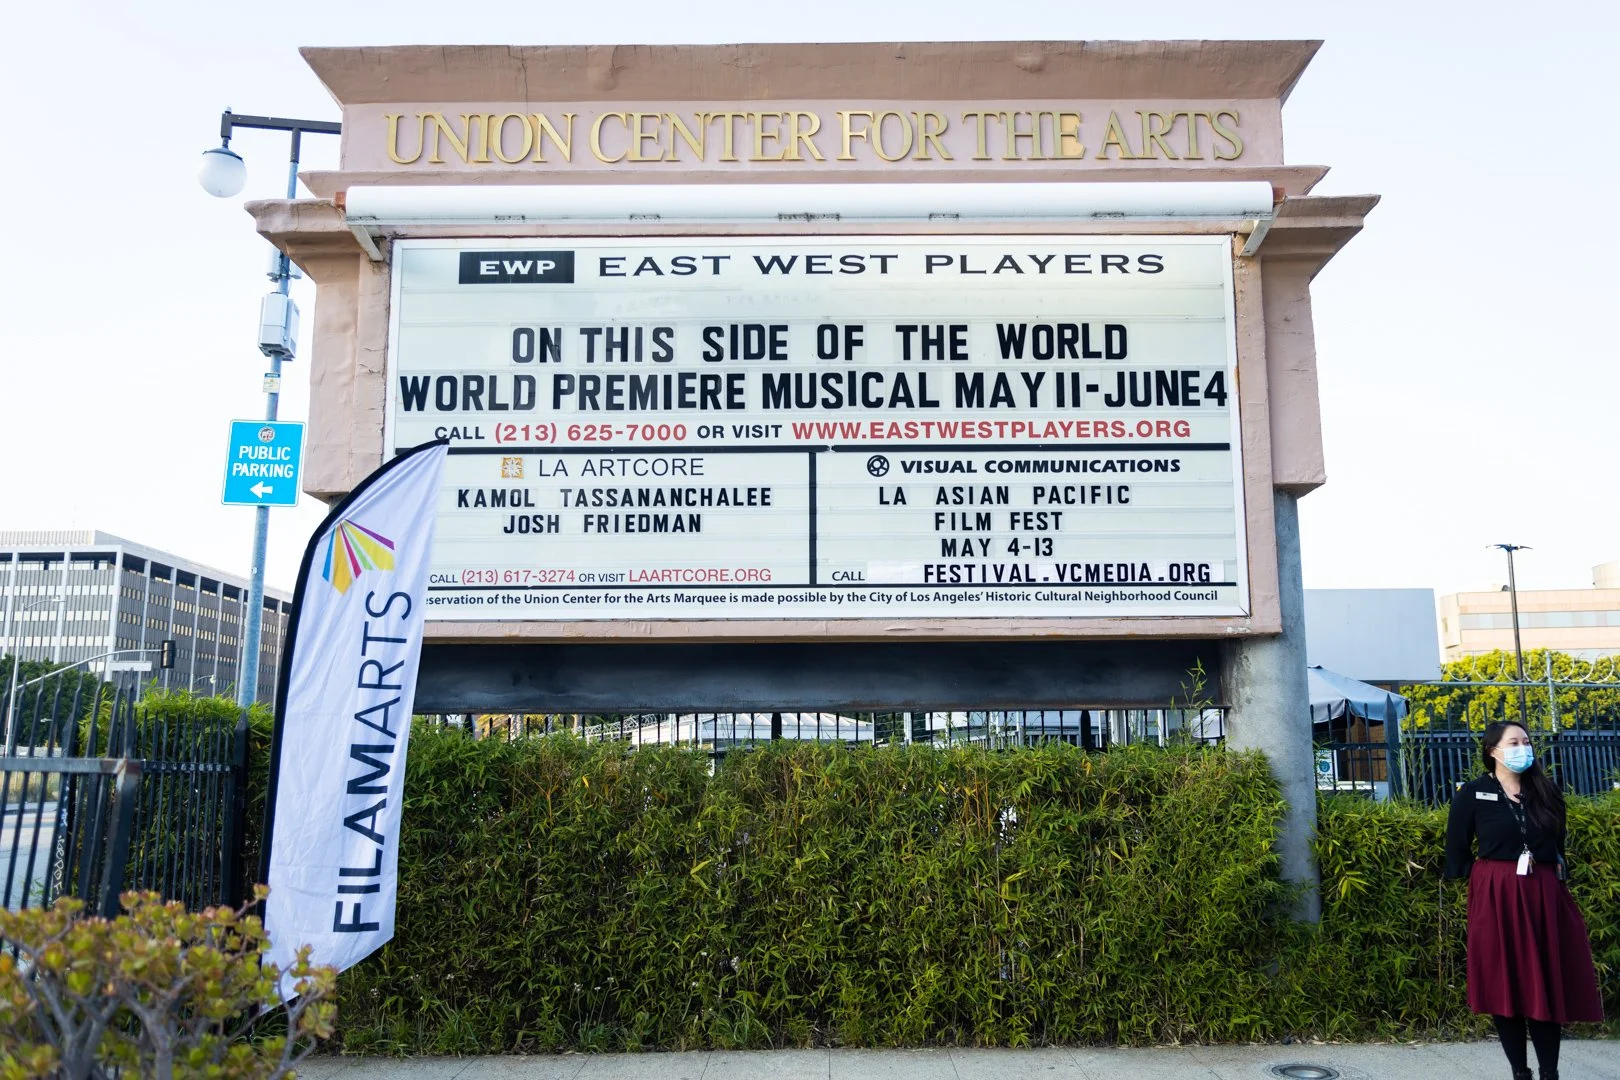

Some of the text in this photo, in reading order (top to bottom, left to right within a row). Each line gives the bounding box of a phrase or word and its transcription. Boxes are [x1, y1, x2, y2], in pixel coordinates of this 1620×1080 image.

[384, 109, 1245, 165] UNION CENTER FOR THE ARTS
[479, 260, 557, 276] EWP
[599, 253, 1166, 277] EAST WEST PLAYERS
[512, 322, 1128, 364] ON THIS SIDE OF THE WORLD
[400, 373, 536, 412] WORLD
[552, 372, 746, 411] PREMIERE
[762, 370, 940, 410] MUSICAL
[434, 420, 1191, 444] CALL (213) 625-7000 OR VISIT WWW.EASTWESTPLAYERS.ORG
[238, 445, 291, 461] PUBLIC
[231, 462, 294, 478] PARKING
[538, 457, 705, 477] LA ARTCORE
[900, 458, 1181, 474] VISUAL COMMUNICATIONS
[457, 487, 772, 508] KAMOL TASSANANCHALEE
[879, 485, 1130, 506] LA ASIAN PACIFIC
[503, 513, 701, 534] JOSH FRIEDMAN
[934, 511, 1063, 531] FILM FEST
[941, 537, 1054, 557] MAY 4-13
[429, 568, 772, 585] CALL (213) 617-3274 OR VISIT LAARTCORE.ORG
[831, 570, 866, 582] CALL
[923, 562, 1212, 584] FESTIVAL.VCMEDIA.ORG
[486, 593, 500, 605] of
[501, 593, 521, 605] the
[524, 593, 560, 604] Union
[562, 593, 602, 604] Center
[604, 593, 622, 604] for
[623, 592, 644, 604] the
[646, 593, 671, 604] Arts
[673, 593, 727, 606] Marquee
[729, 592, 739, 603] is
[741, 592, 775, 603] made
[777, 591, 827, 605] possible
[829, 591, 844, 605] by
[846, 591, 867, 602] the
[869, 591, 893, 605] City
[895, 591, 908, 602] of
[910, 591, 931, 602] Los
[985, 591, 1031, 602] Historic
[1034, 590, 1082, 602] Cultural
[1084, 590, 1171, 604] Neighborhood
[1173, 590, 1218, 601] Council
[332, 589, 413, 933] FILAMARTS
